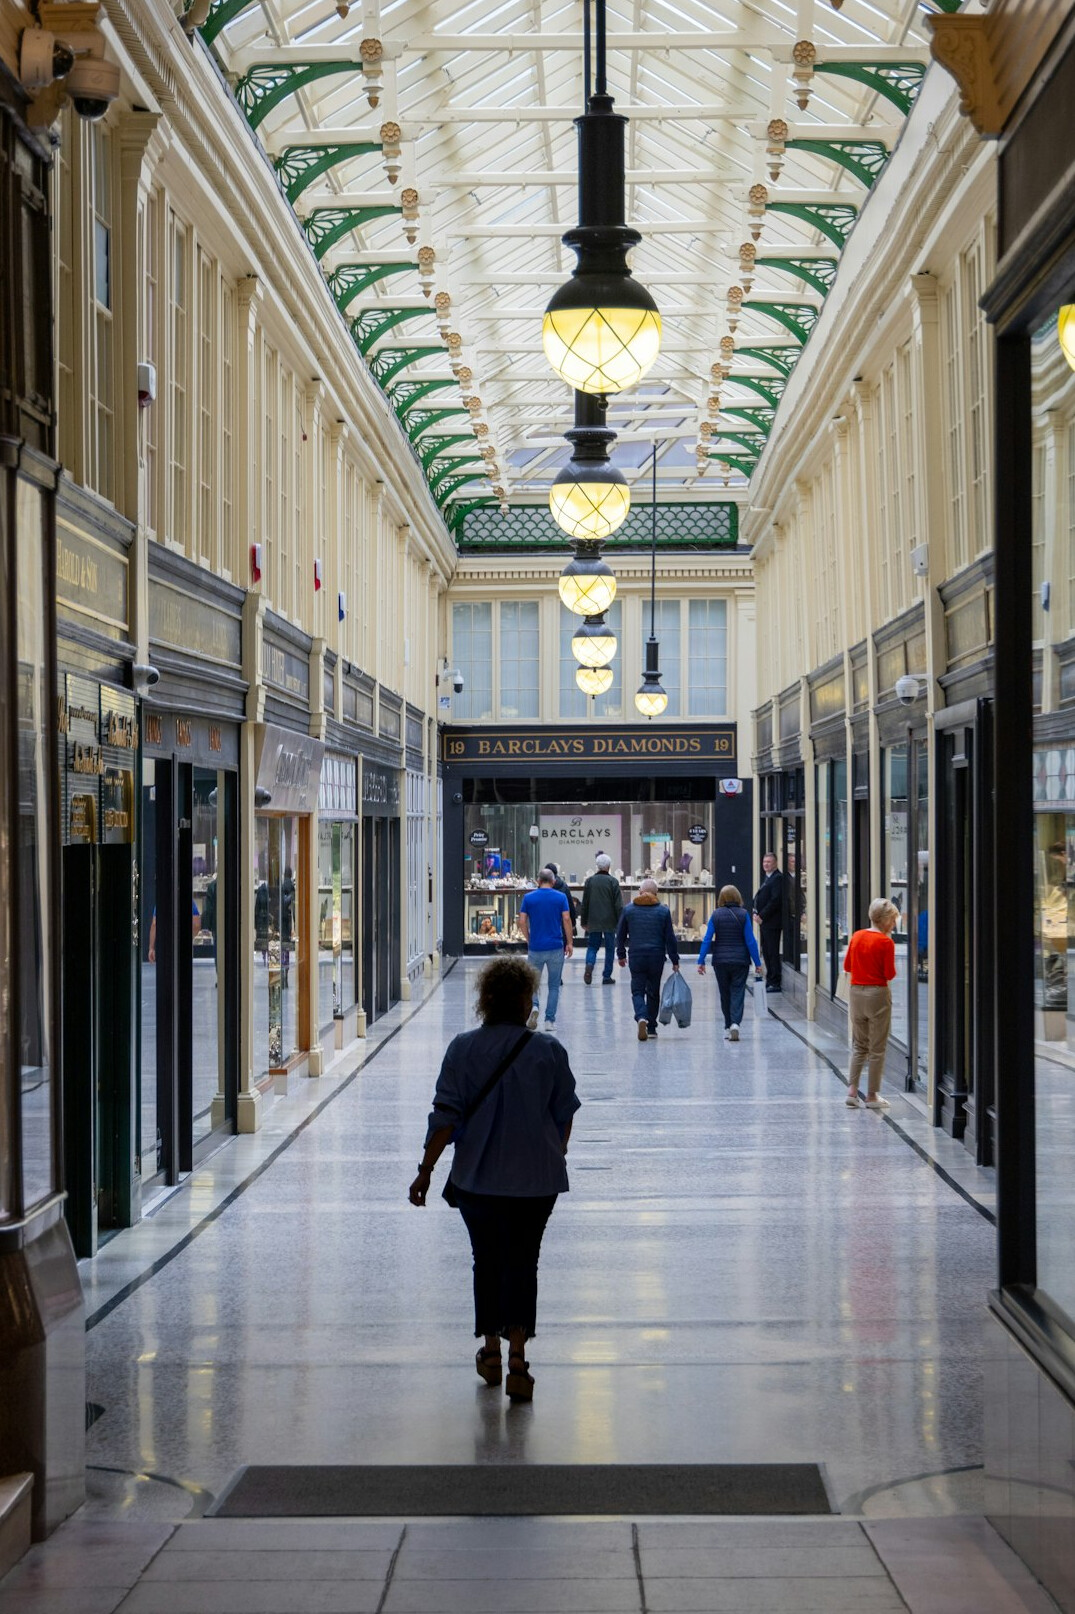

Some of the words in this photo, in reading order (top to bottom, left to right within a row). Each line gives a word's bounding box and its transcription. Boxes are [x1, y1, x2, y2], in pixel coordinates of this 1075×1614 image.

[449, 741, 465, 754] 19
[478, 740, 584, 754] BARCLAYS
[593, 738, 701, 753] DIAMONDS
[714, 740, 729, 752] 19
[541, 829, 611, 838] BARCLAYS
